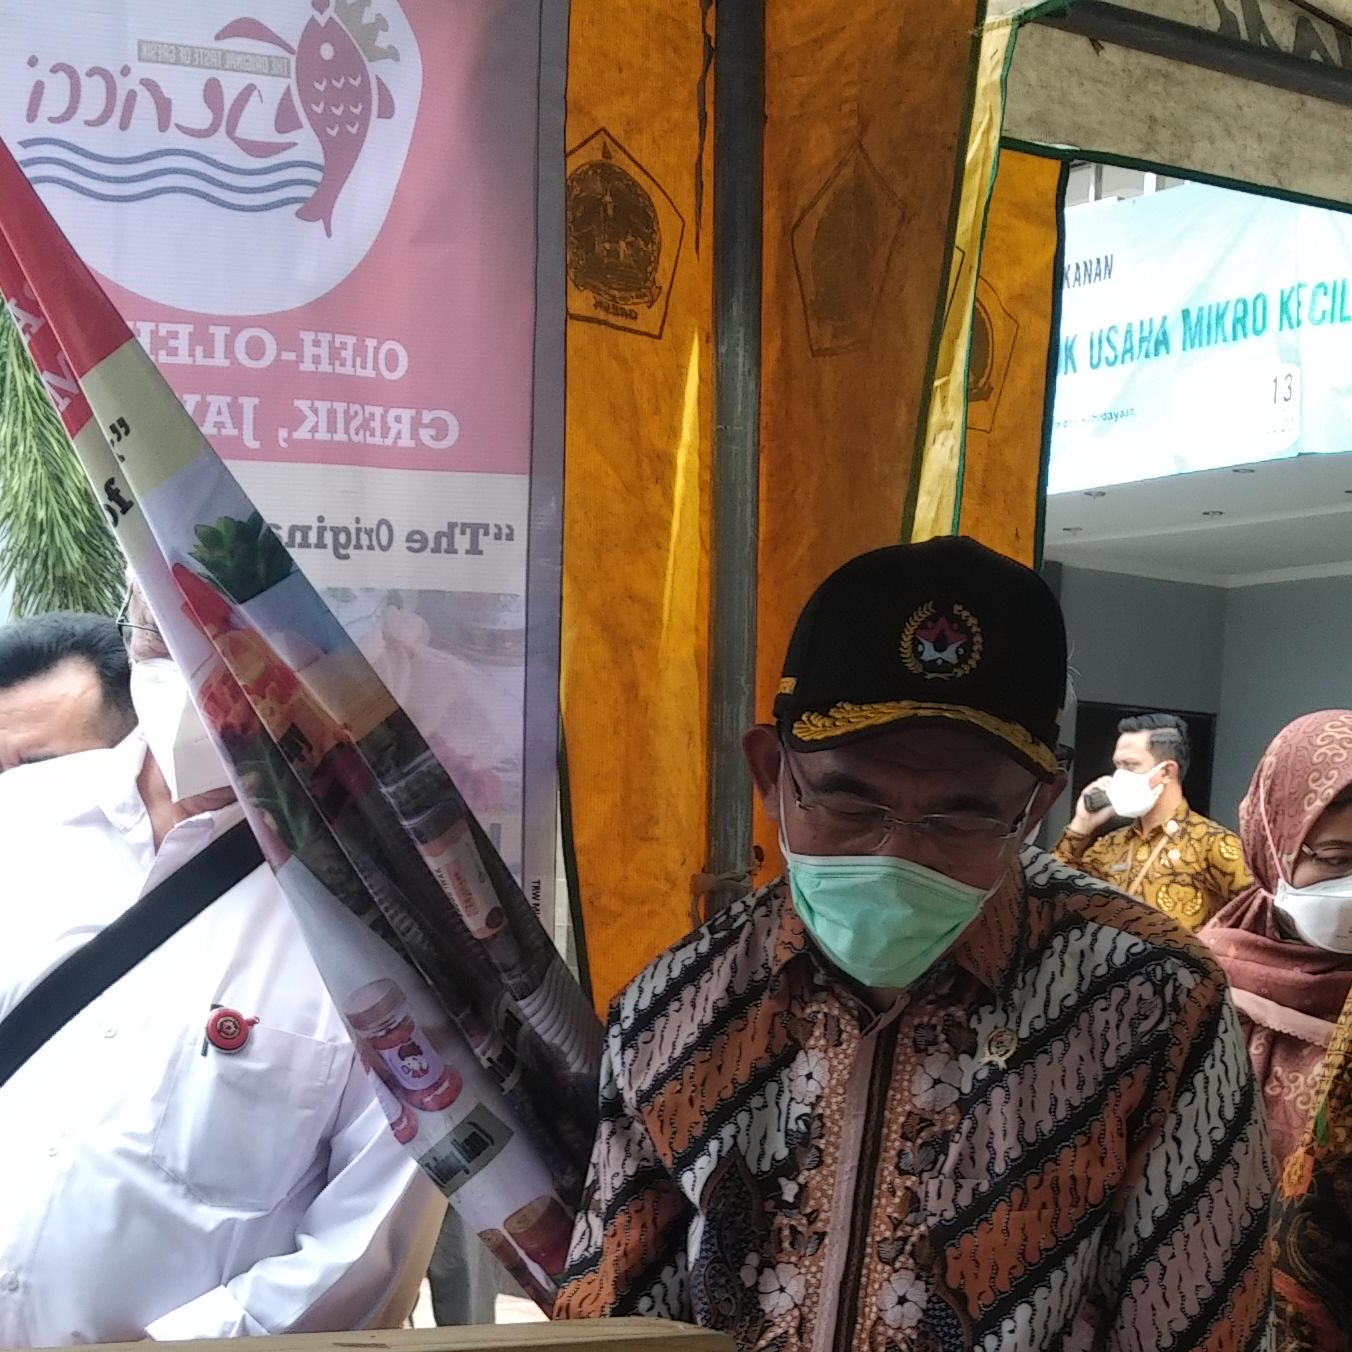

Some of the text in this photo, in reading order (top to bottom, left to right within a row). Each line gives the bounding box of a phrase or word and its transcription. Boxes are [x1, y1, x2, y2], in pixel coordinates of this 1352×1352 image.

[1089, 315, 1171, 369] USAHA
[1181, 292, 1268, 351] MIKRO
[1278, 278, 1352, 331] KECIL
[1271, 372, 1294, 404] 13
